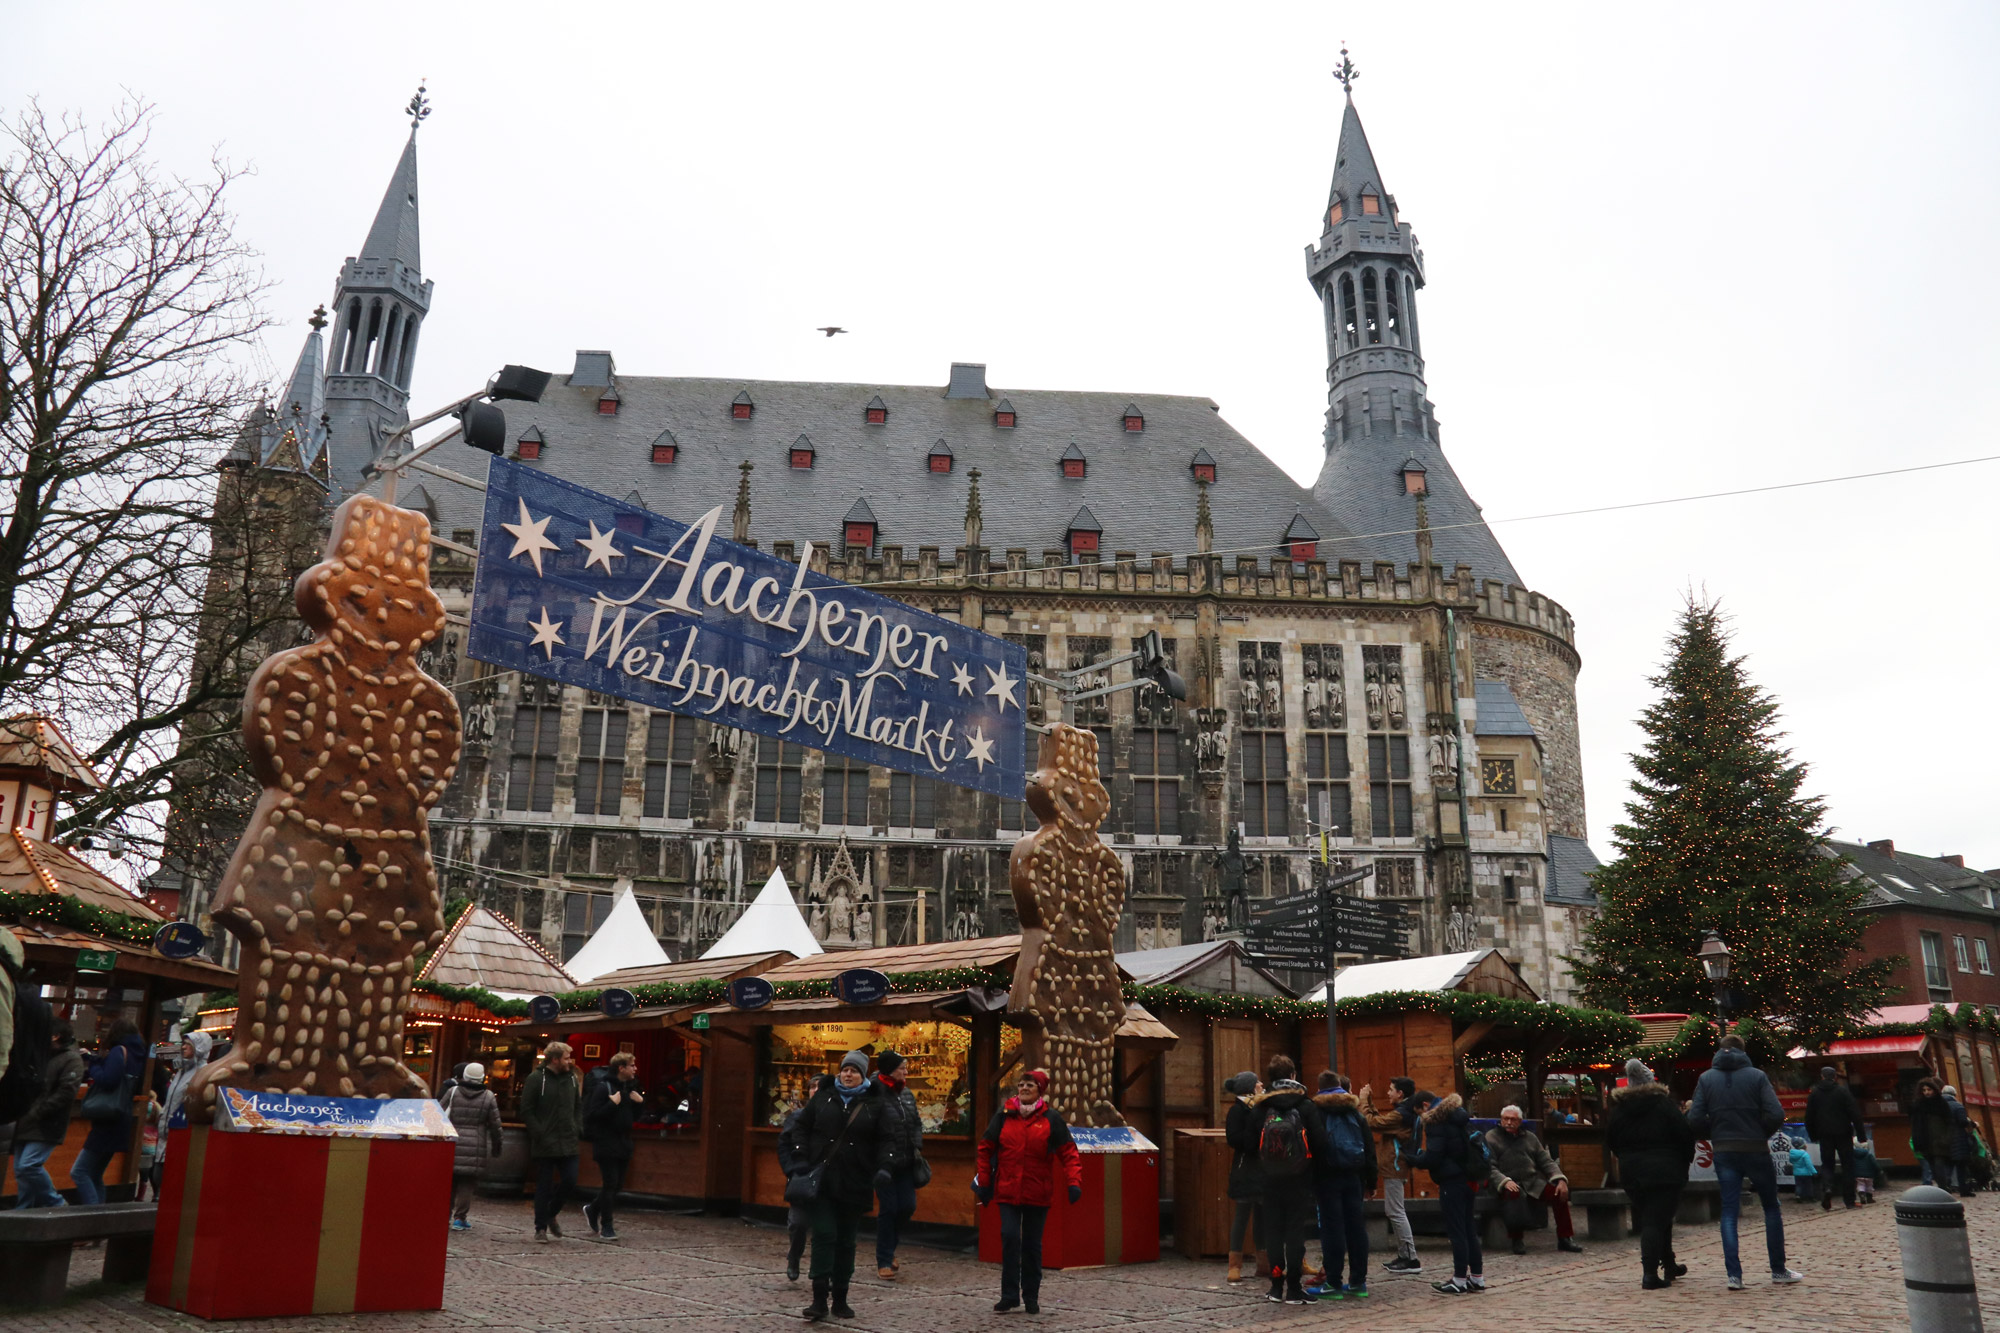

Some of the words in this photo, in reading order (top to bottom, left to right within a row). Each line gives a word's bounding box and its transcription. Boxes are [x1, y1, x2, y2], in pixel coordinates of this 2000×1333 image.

[595, 504, 949, 678] Aachener
[584, 597, 957, 772] WeihnachtsMarkt
[1275, 894, 1305, 905] Couven-Museum
[1363, 916, 1387, 926] Charlemagne
[1350, 929, 1386, 938] Domschatzkammer
[232, 1094, 344, 1118] Aachener
